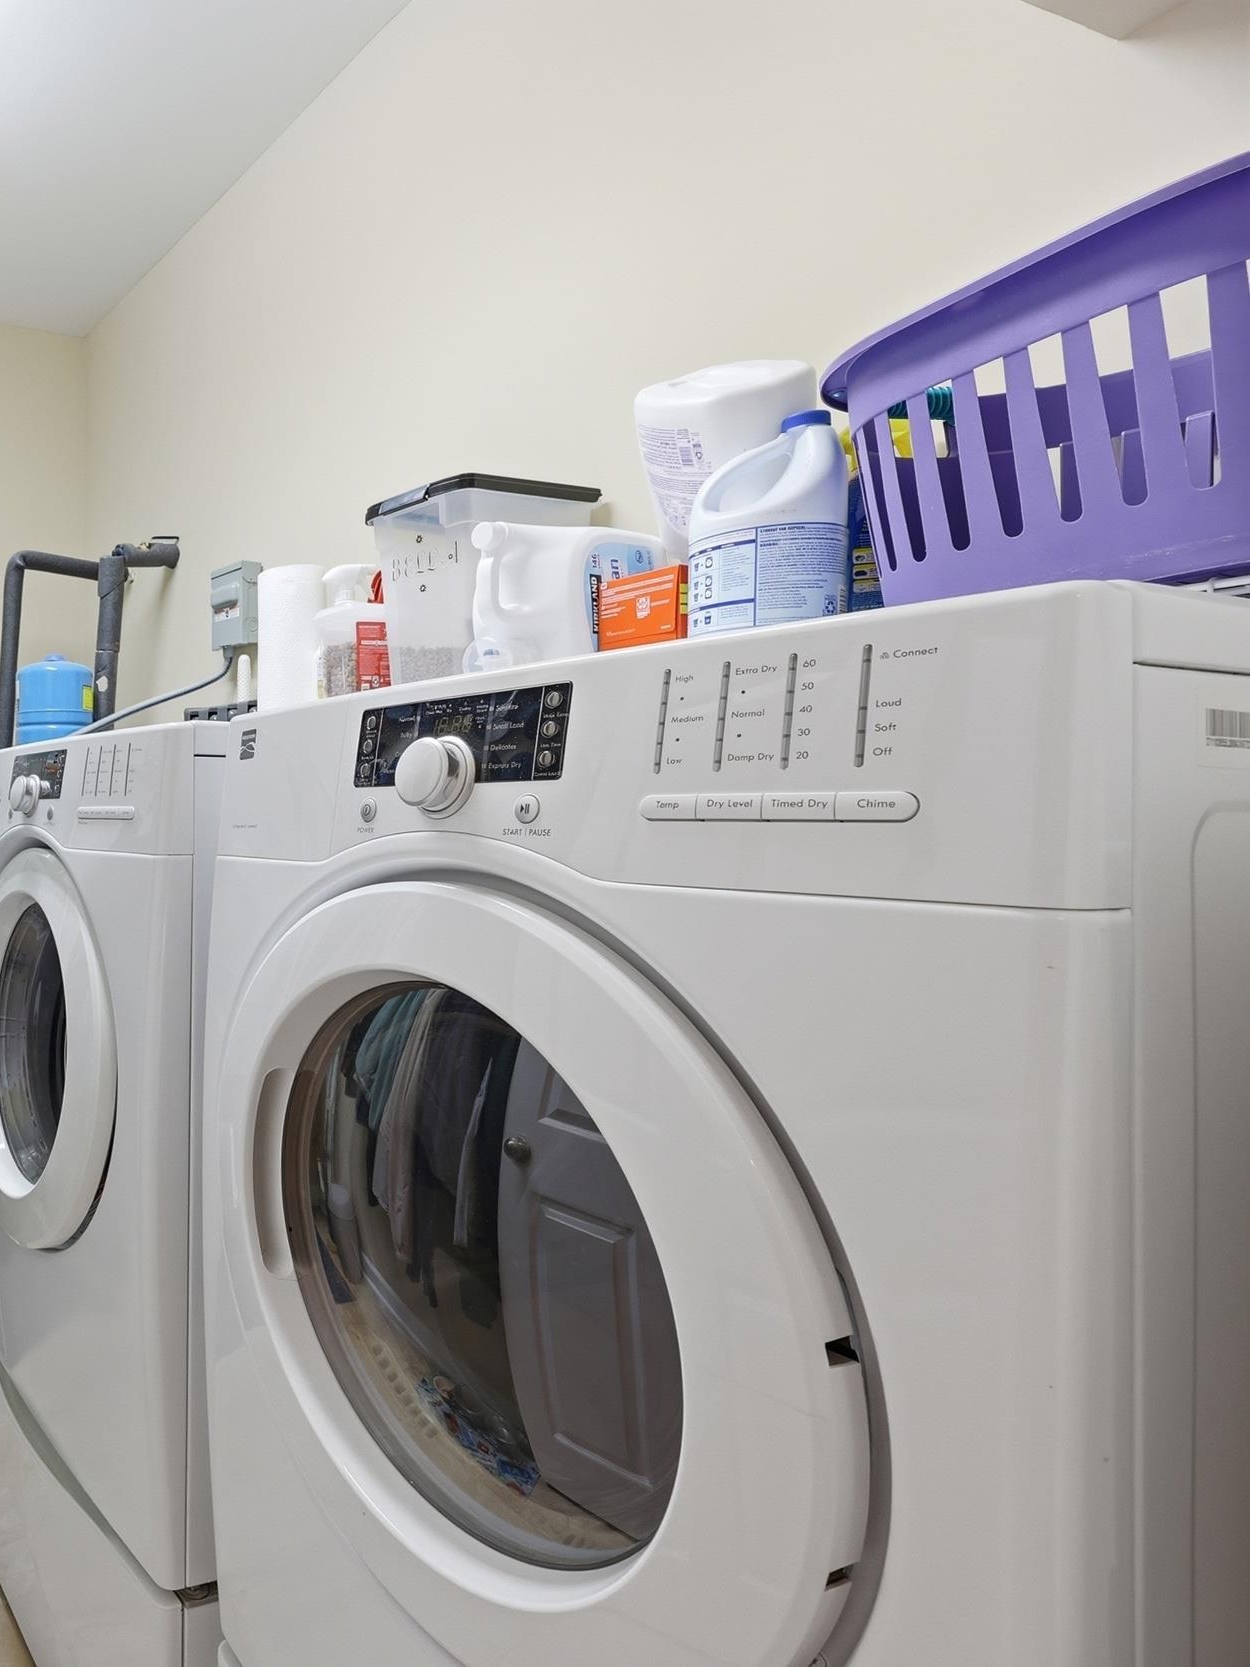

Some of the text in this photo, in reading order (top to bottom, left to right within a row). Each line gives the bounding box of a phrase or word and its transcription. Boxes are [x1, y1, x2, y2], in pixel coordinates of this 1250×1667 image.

[893, 647, 939, 659] Connect
[803, 659, 816, 668] 60
[735, 664, 778, 676] Extra Dry
[675, 674, 694, 684] High
[801, 681, 814, 691] 50
[875, 698, 902, 708] Loud
[731, 709, 765, 719] Normal
[800, 705, 813, 714] 40
[670, 715, 704, 724] Medium
[797, 727, 811, 737] 30
[874, 723, 897, 732] Soft
[796, 751, 809, 760] 20
[872, 746, 893, 757] Off
[667, 757, 682, 765] Low
[727, 753, 774, 763] Damp Dry
[656, 801, 679, 810] Temp
[706, 799, 753, 809] Dry Level
[771, 799, 828, 810] Timed Dry
[857, 798, 896, 809] Chime
[502, 828, 551, 837] START PAUSE
